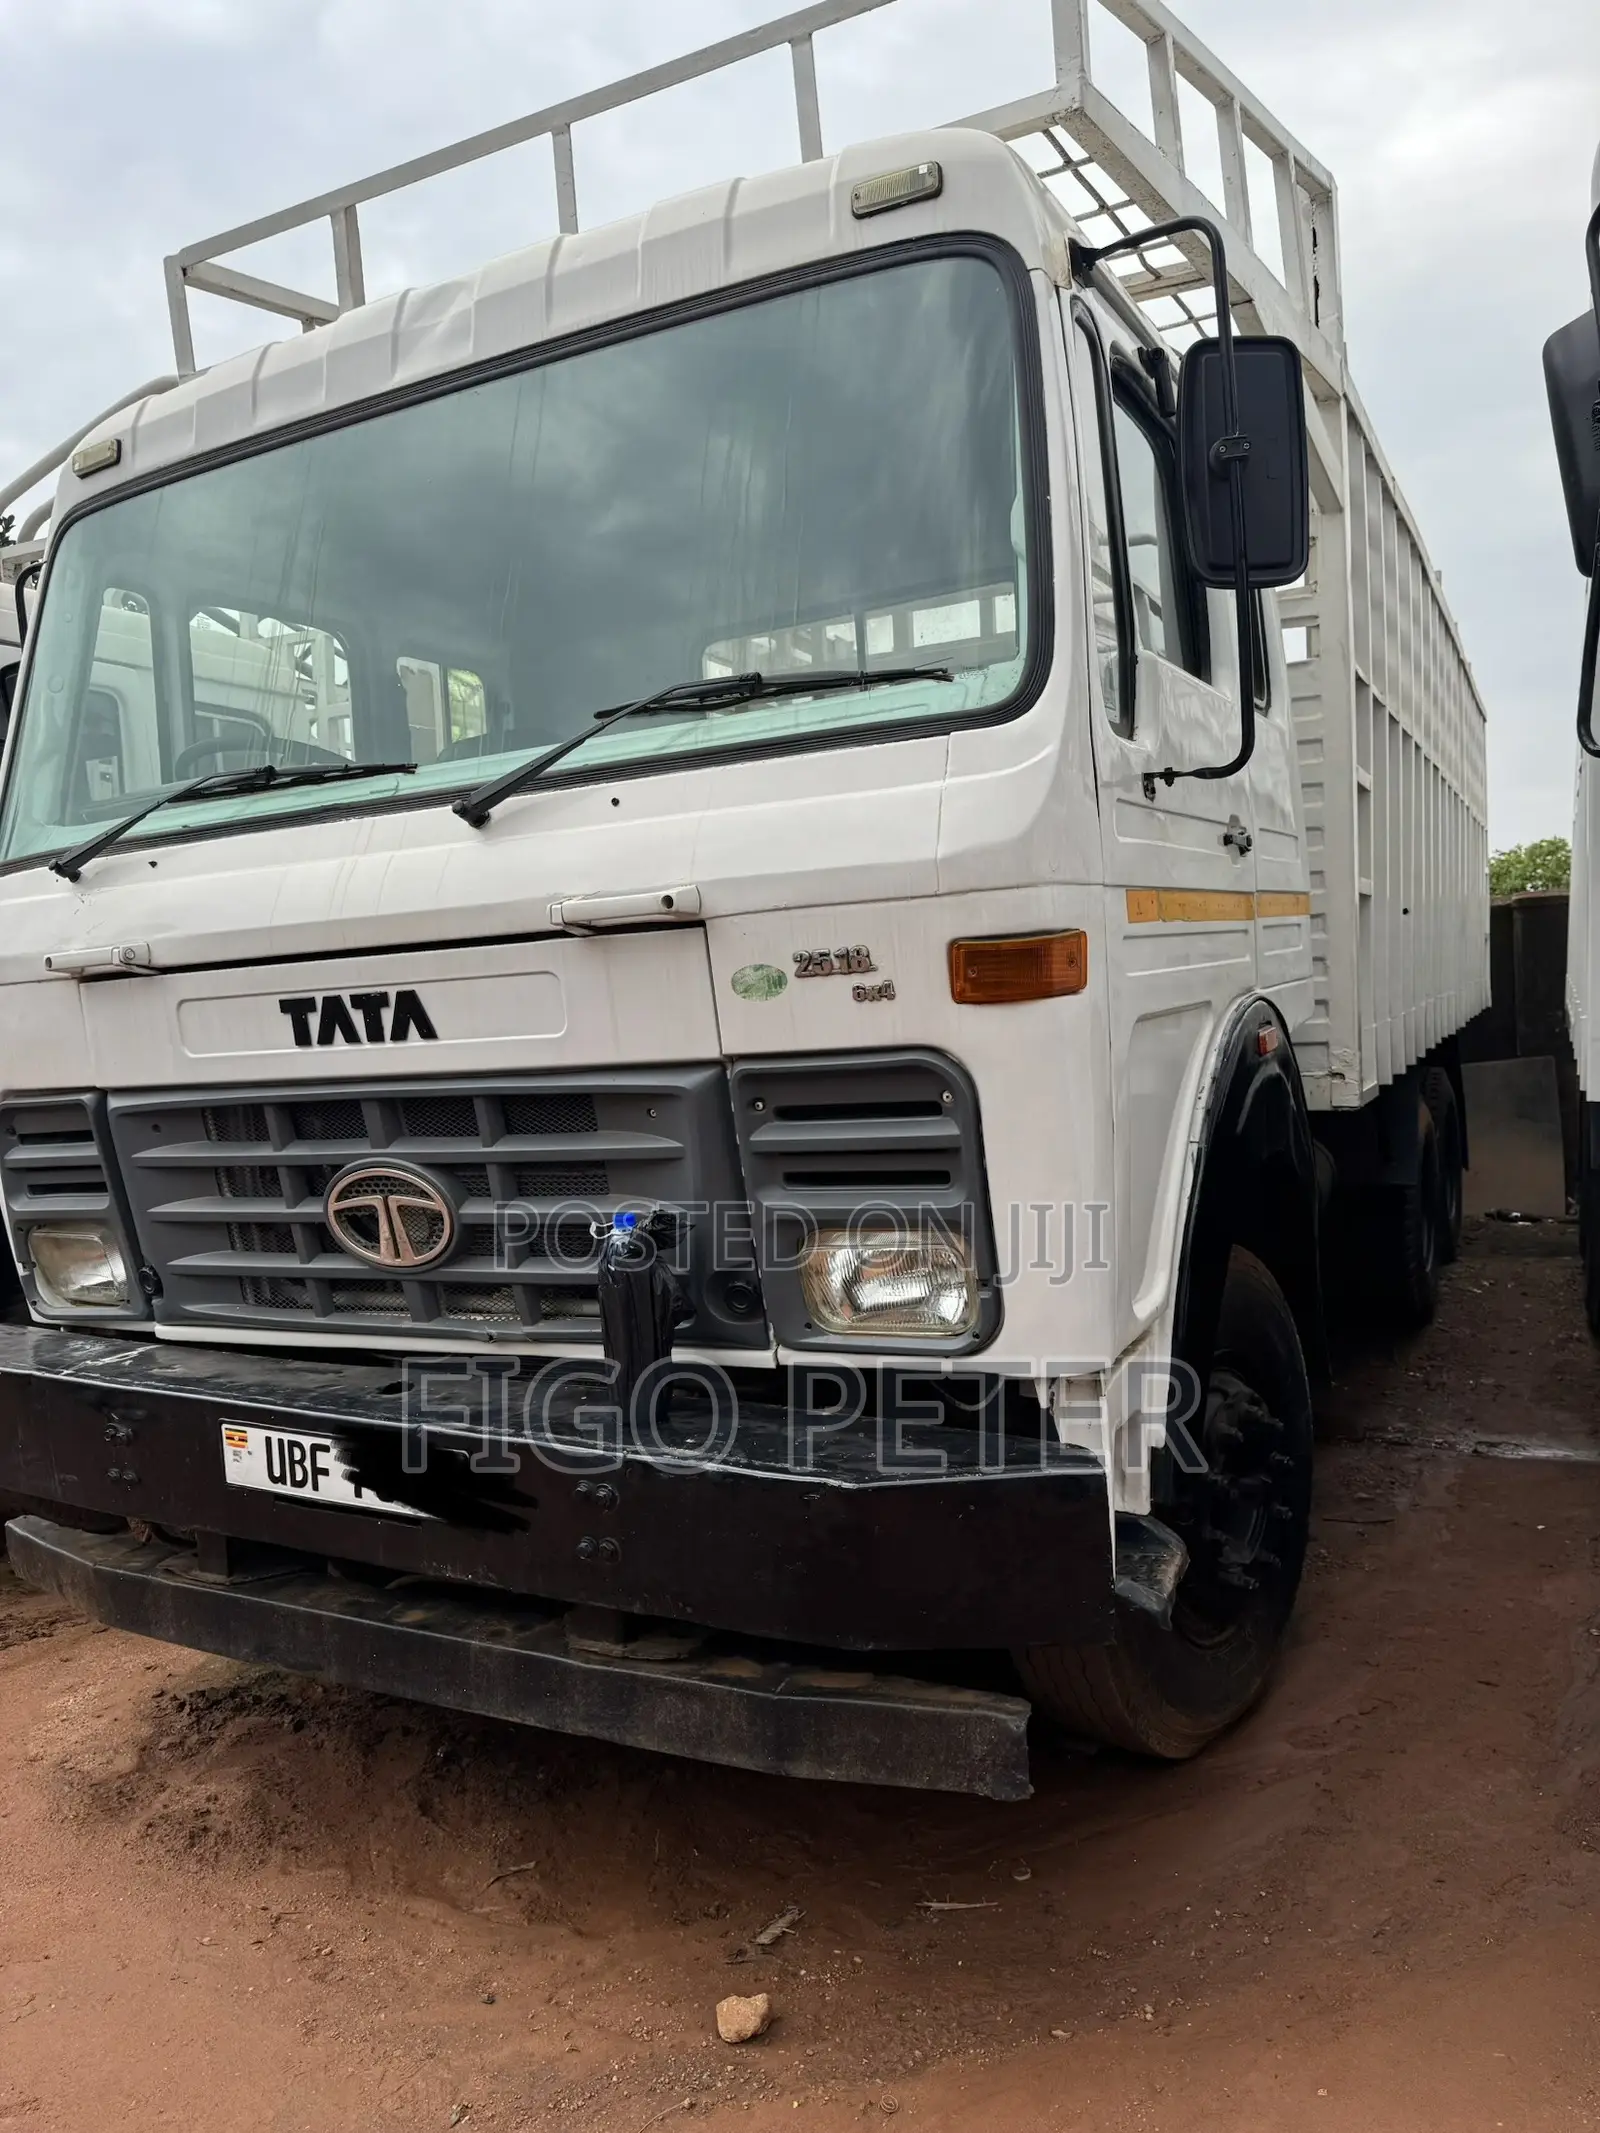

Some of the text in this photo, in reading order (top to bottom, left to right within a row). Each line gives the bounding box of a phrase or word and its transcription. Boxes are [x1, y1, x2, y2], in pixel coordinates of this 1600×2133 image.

[793, 945, 873, 978] 2518
[852, 979, 896, 1002] 6x4
[278, 990, 439, 1047] TATA
[264, 1435, 331, 1492] UBF
